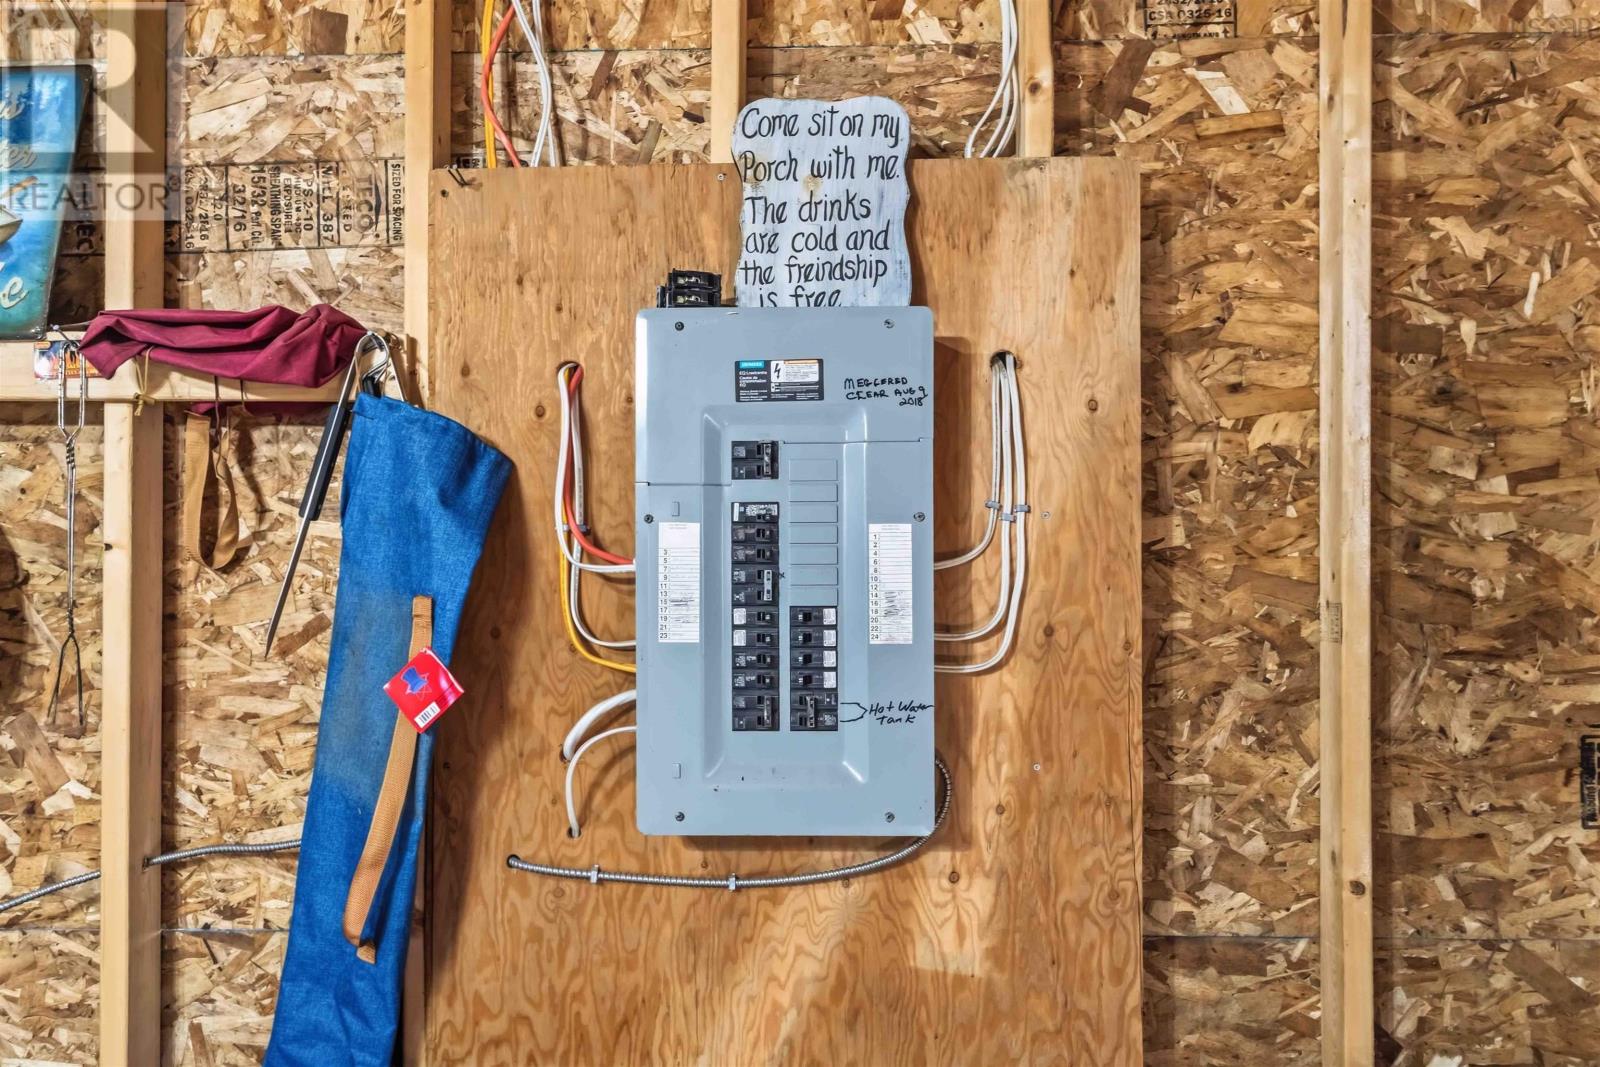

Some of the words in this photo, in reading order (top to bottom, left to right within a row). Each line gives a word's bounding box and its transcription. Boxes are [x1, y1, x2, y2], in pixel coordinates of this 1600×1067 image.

[742, 108, 800, 139] Come
[808, 106, 840, 137] sit
[840, 113, 864, 137] on
[871, 113, 900, 148] my
[392, 163, 400, 187] SIZED
[740, 150, 798, 182] Porch
[810, 145, 855, 180] with
[251, 168, 266, 207] 15/32
[270, 166, 281, 216] SHEATHING
[284, 178, 292, 226] EXPOSURE
[356, 174, 374, 232] TECO
[392, 188, 401, 205] FOR
[232, 184, 247, 232] 32/16
[392, 206, 402, 241] SPACING
[744, 196, 788, 224] The
[798, 188, 871, 222] drinks
[322, 214, 334, 242] 387
[745, 231, 779, 254] are
[791, 224, 838, 252] cold
[846, 219, 890, 251] and
[739, 260, 775, 286] the
[784, 254, 888, 288] freindship
[759, 287, 777, 307] is
[894, 388, 916, 396] AUG
[899, 396, 923, 406] 2018
[869, 701, 894, 716] Hot
[876, 714, 916, 725] Tank
